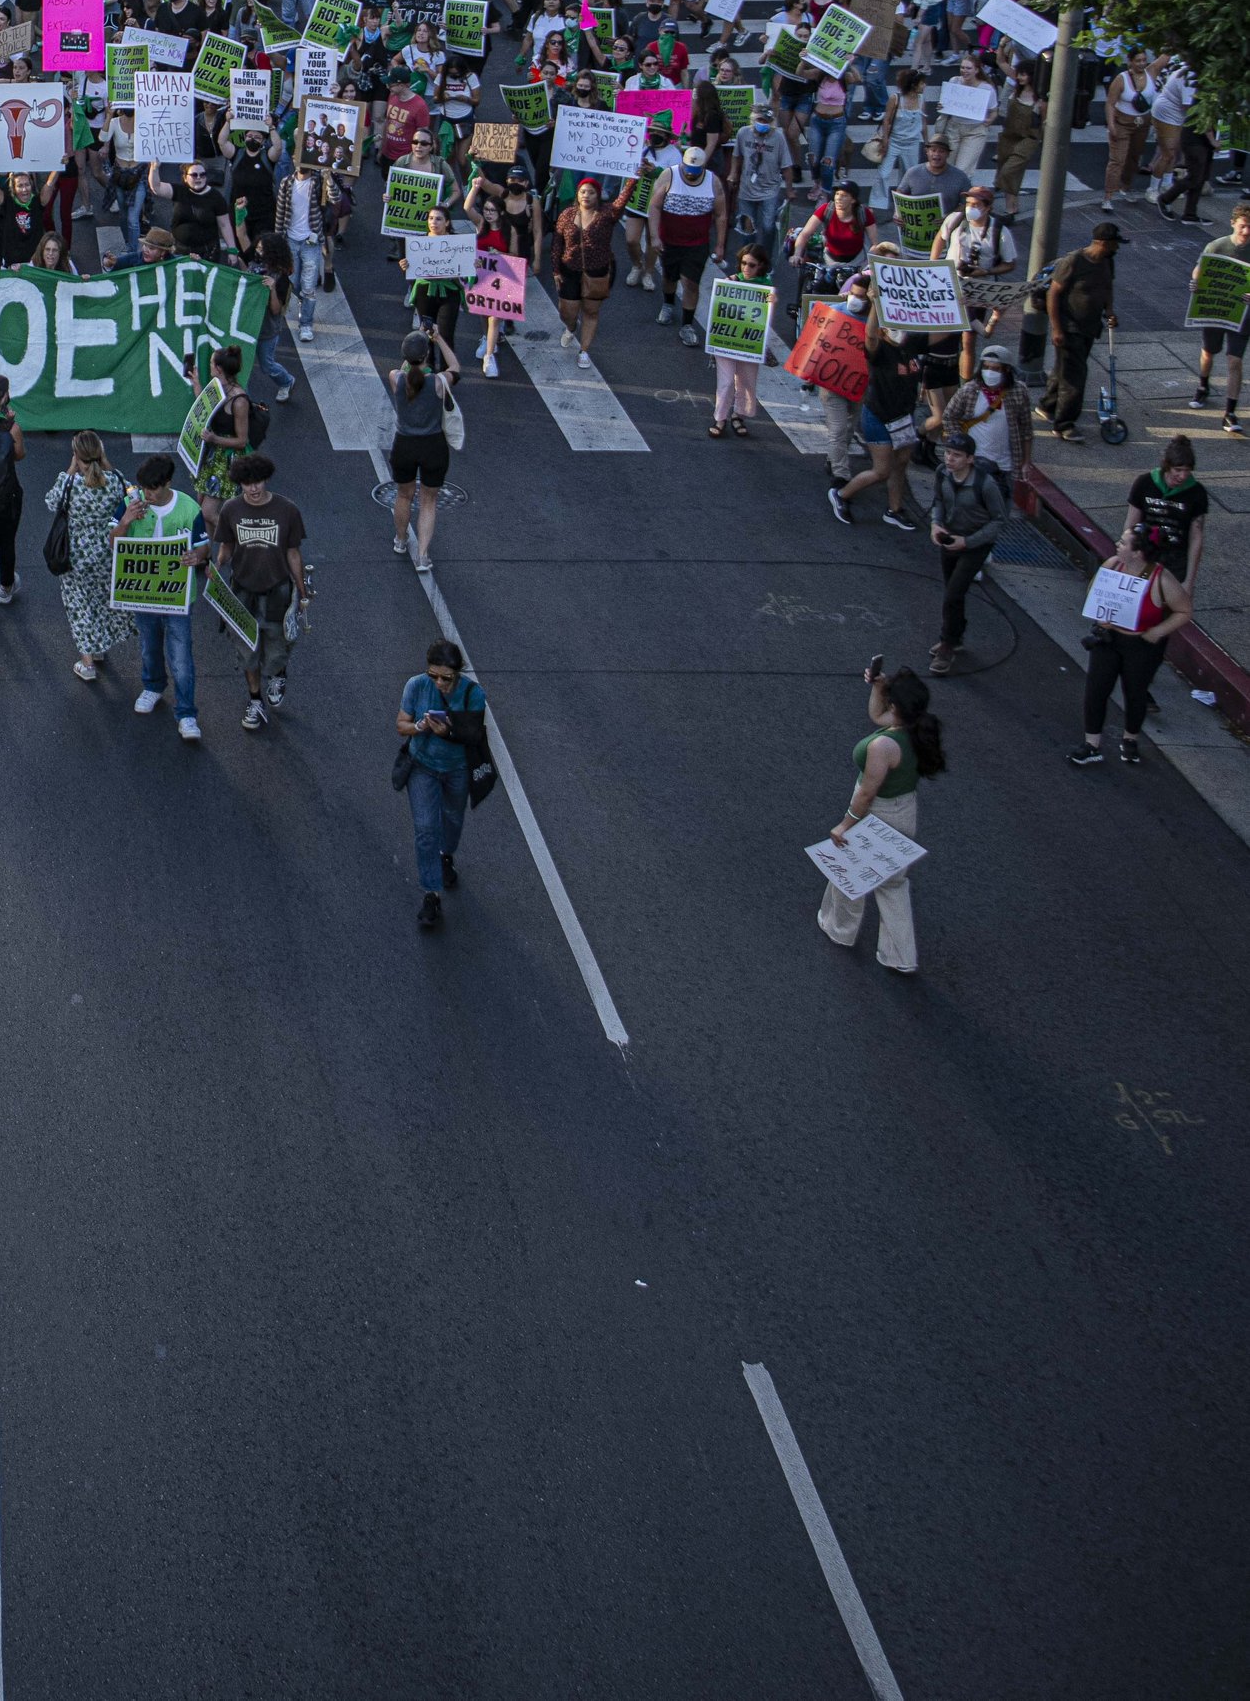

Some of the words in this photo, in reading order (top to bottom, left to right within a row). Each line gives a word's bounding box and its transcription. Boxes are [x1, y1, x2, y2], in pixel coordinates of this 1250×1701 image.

[112, 58, 145, 66] Supreme
[308, 51, 327, 59] KEEP
[307, 60, 327, 68] YOUR
[243, 71, 258, 79] FREE
[302, 69, 330, 77] FASCIST
[136, 74, 191, 92] HUMAN
[234, 77, 266, 86] ABORTION
[303, 78, 328, 86] HANDS
[245, 90, 255, 98] ON
[309, 86, 322, 94] OFF
[138, 95, 189, 107] RIGHTS
[237, 98, 264, 107] DEMAND
[236, 106, 264, 115] WITHOUT
[307, 102, 357, 115] CHRISTOFASCISTS
[236, 113, 264, 122] APOLOGY
[139, 123, 191, 137] STATES
[476, 124, 492, 137] OUR
[493, 125, 518, 138] BODIES
[473, 136, 491, 148] OUR
[491, 137, 515, 149] CHOICE
[568, 130, 584, 142] MY
[591, 132, 625, 147] BODY
[142, 138, 192, 156] RIGHTS
[576, 144, 605, 156] NOT
[559, 152, 587, 164] YOUR
[390, 172, 438, 190] OVERTURN
[393, 188, 418, 204] ROE
[880, 265, 928, 287] GUNS
[491, 277, 501, 290] 4
[715, 284, 769, 303] OVERTURN
[878, 285, 918, 302] MORE
[129, 261, 257, 344] HELL
[900, 301, 931, 309] THAN
[717, 302, 745, 322] ROE
[886, 307, 955, 324] WOMEN!!!
[709, 322, 738, 338] HELL
[742, 328, 764, 342] NO!
[815, 332, 844, 353] Her
[793, 344, 868, 397] CHOICE
[239, 527, 275, 544] HOMEBOY
[117, 542, 187, 556] OVERTURN
[123, 558, 159, 575] ROE
[115, 578, 152, 591] HELL
[157, 579, 187, 594] NO!
[1118, 575, 1143, 593] LIE
[1096, 605, 1119, 623] DIE
